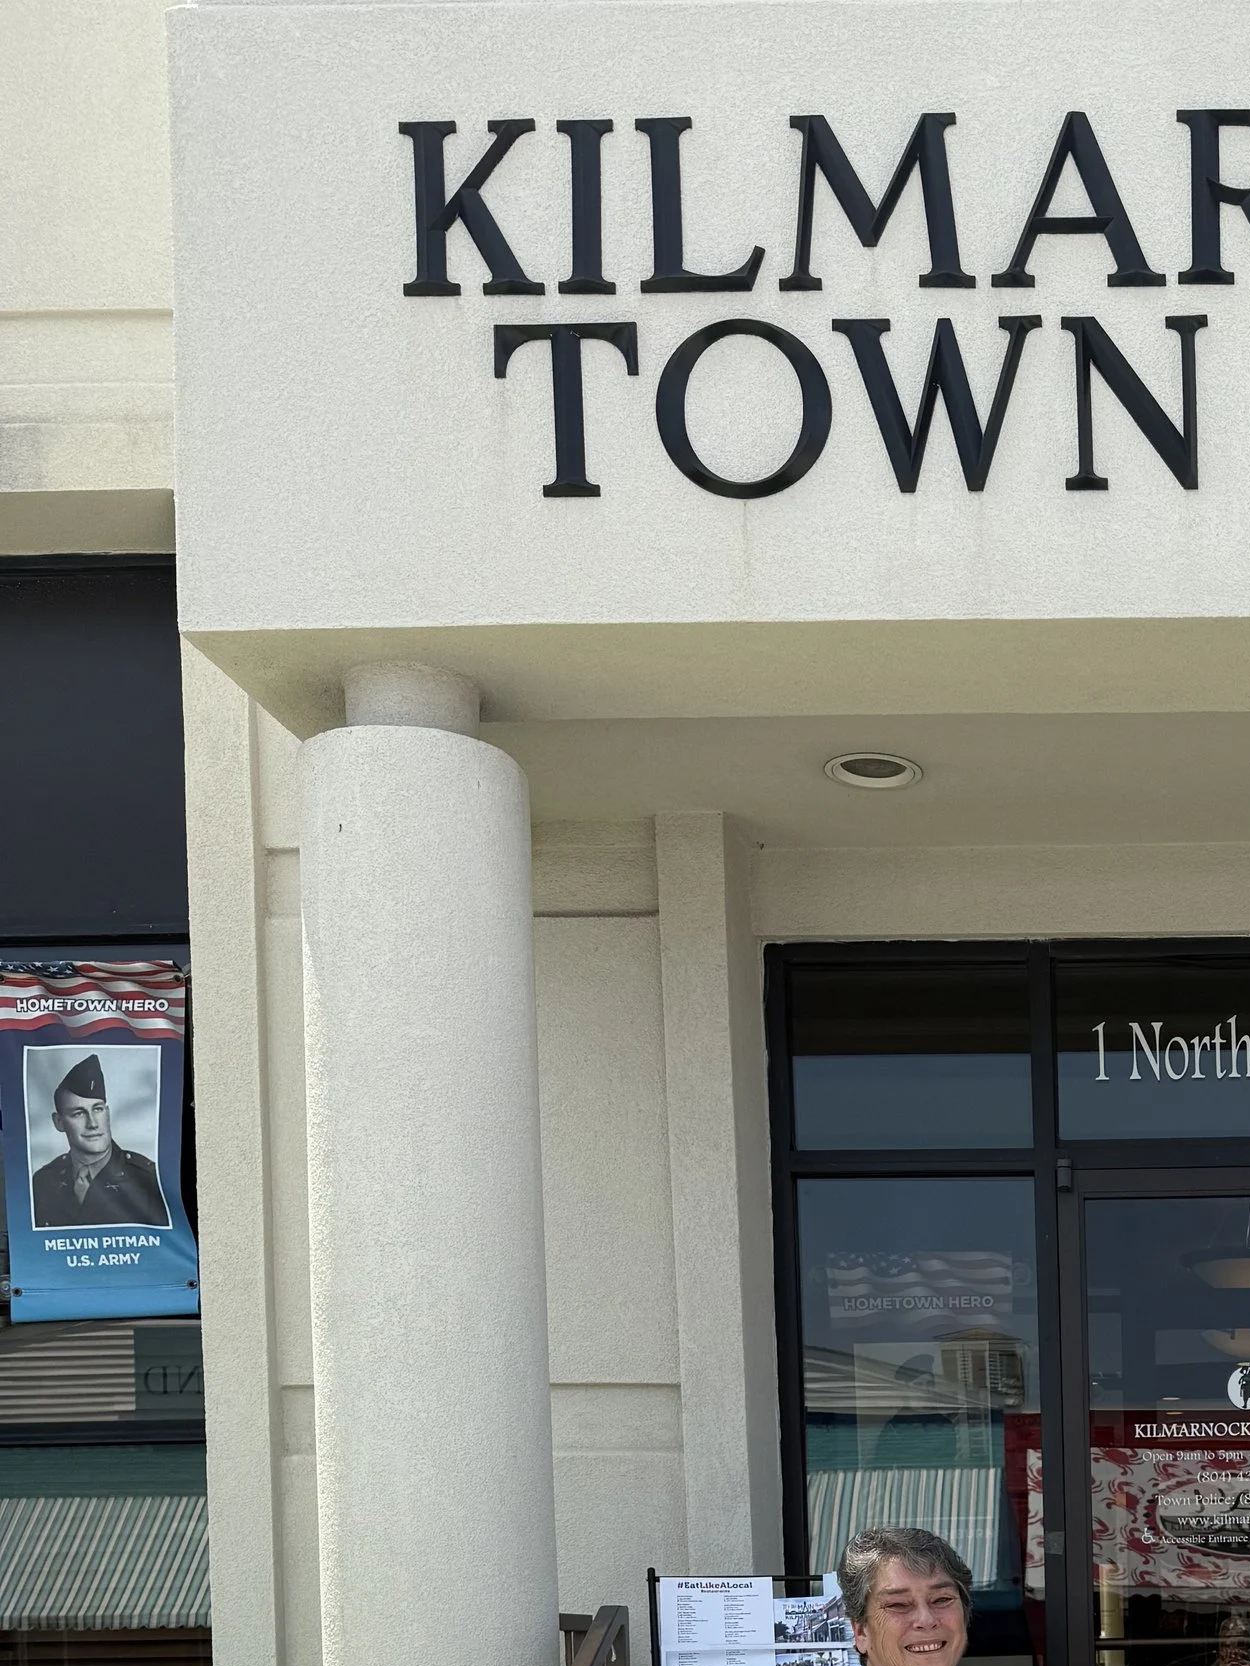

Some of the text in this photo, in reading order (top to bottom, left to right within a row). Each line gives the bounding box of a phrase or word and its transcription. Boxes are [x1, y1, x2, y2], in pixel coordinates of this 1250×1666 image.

[494, 313, 1209, 500] TOWN
[16, 997, 169, 1013] HOMETOWN HERO
[1091, 1021, 1111, 1083] 1
[45, 1235, 161, 1251] MELVIN PITMAN
[66, 1253, 140, 1267] U.S. ARMY
[844, 1293, 995, 1312] HOMETOWN HERO
[1142, 1451, 1173, 1464] Open
[1175, 1451, 1201, 1462] 9am
[1218, 1450, 1244, 1463] 5pm
[1196, 1470, 1232, 1484] (804)
[1155, 1494, 1191, 1508] Town
[1194, 1493, 1236, 1507] Police:
[1159, 1533, 1206, 1545] Accessible
[1208, 1532, 1249, 1544] Entrance
[677, 1581, 753, 1589] #EatLikeALocal
